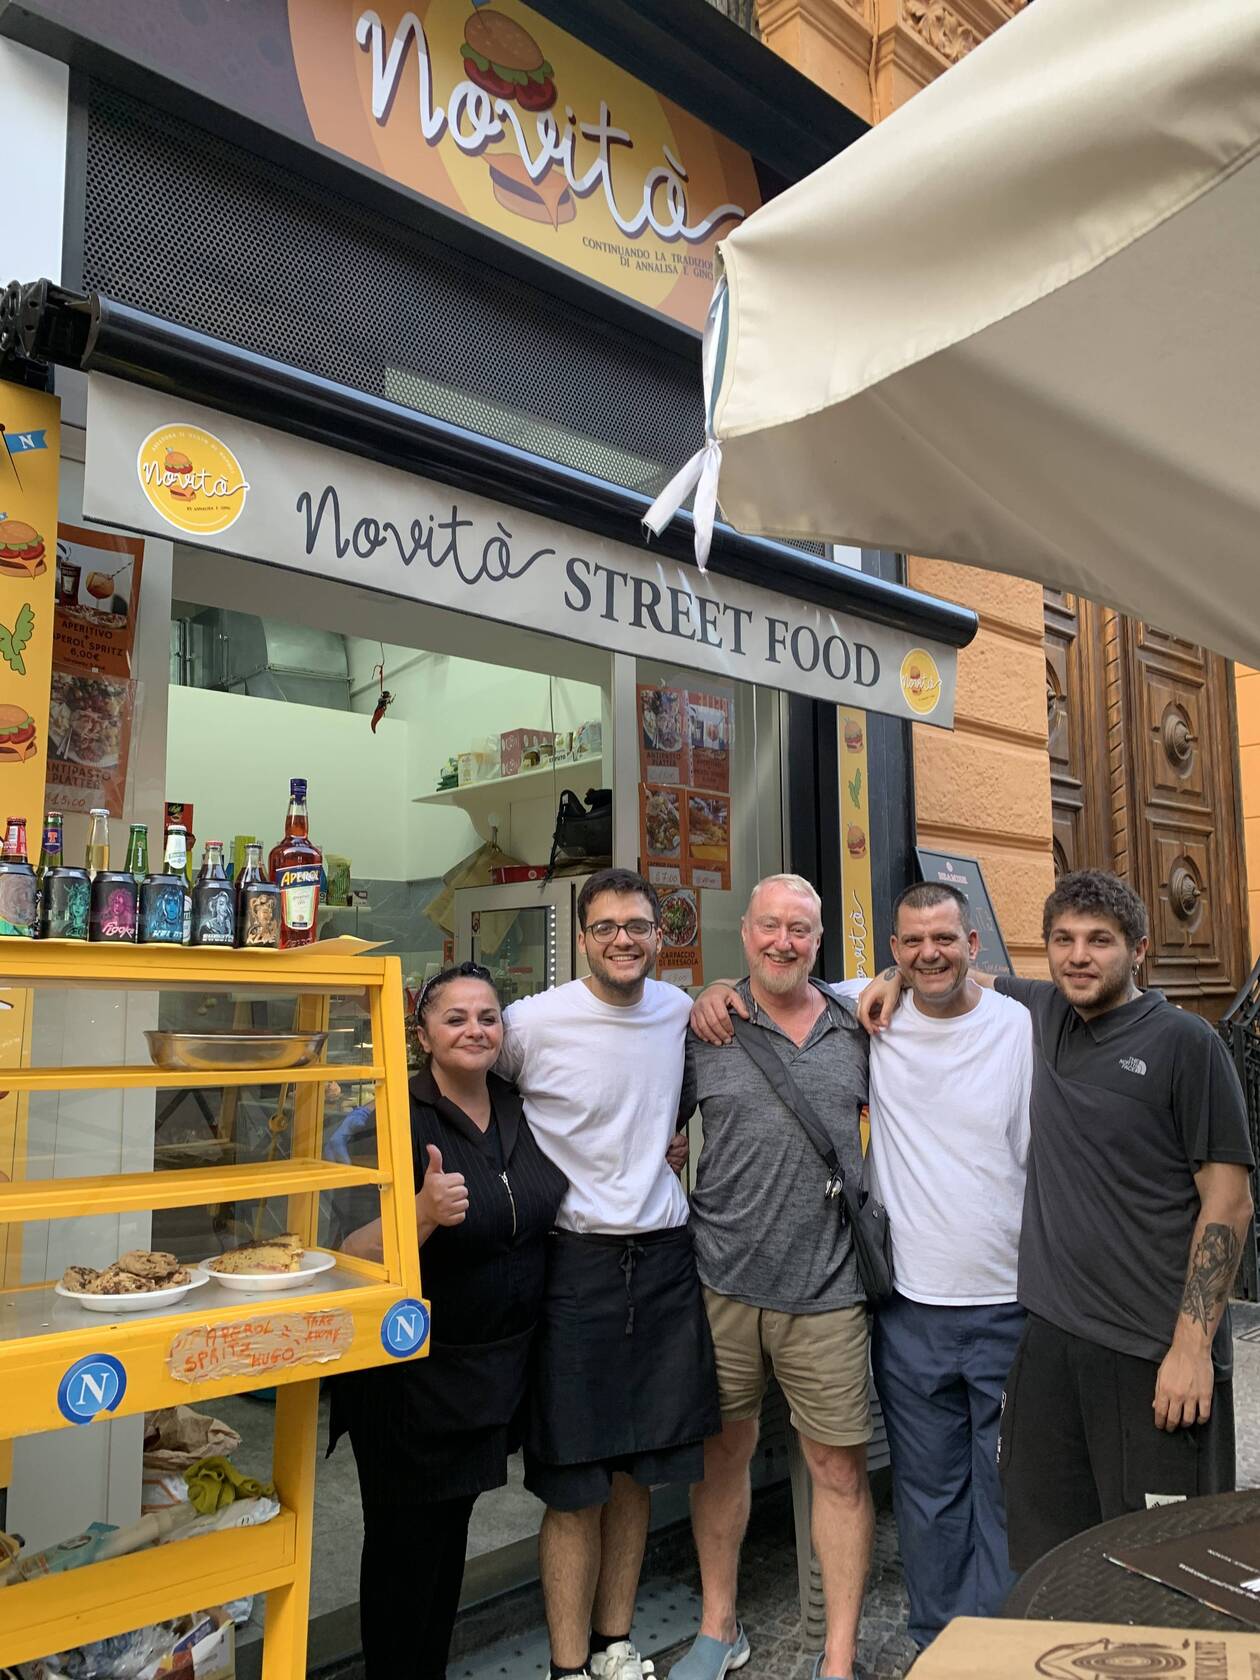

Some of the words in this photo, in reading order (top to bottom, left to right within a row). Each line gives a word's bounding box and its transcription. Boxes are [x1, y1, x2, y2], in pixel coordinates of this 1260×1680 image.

[356, 9, 744, 243] Novità
[582, 236, 650, 260] CONTINUANDO
[655, 251, 666, 262] LA
[620, 257, 630, 268] DI
[635, 262, 679, 275] ANNALISA
[18, 434, 36, 449] N
[143, 461, 251, 498] Novità
[296, 485, 556, 585] Novità
[564, 557, 752, 656] STREET
[764, 616, 881, 688] FOOD
[62, 620, 113, 639] APERITIVO
[280, 870, 320, 887] APEROL
[849, 889, 868, 978] ovità
[205, 1320, 274, 1347] APEROL
[393, 1314, 417, 1343] N
[184, 1342, 252, 1373] SPRITZ
[251, 1347, 294, 1368] HUGO
[78, 1373, 109, 1406] N
